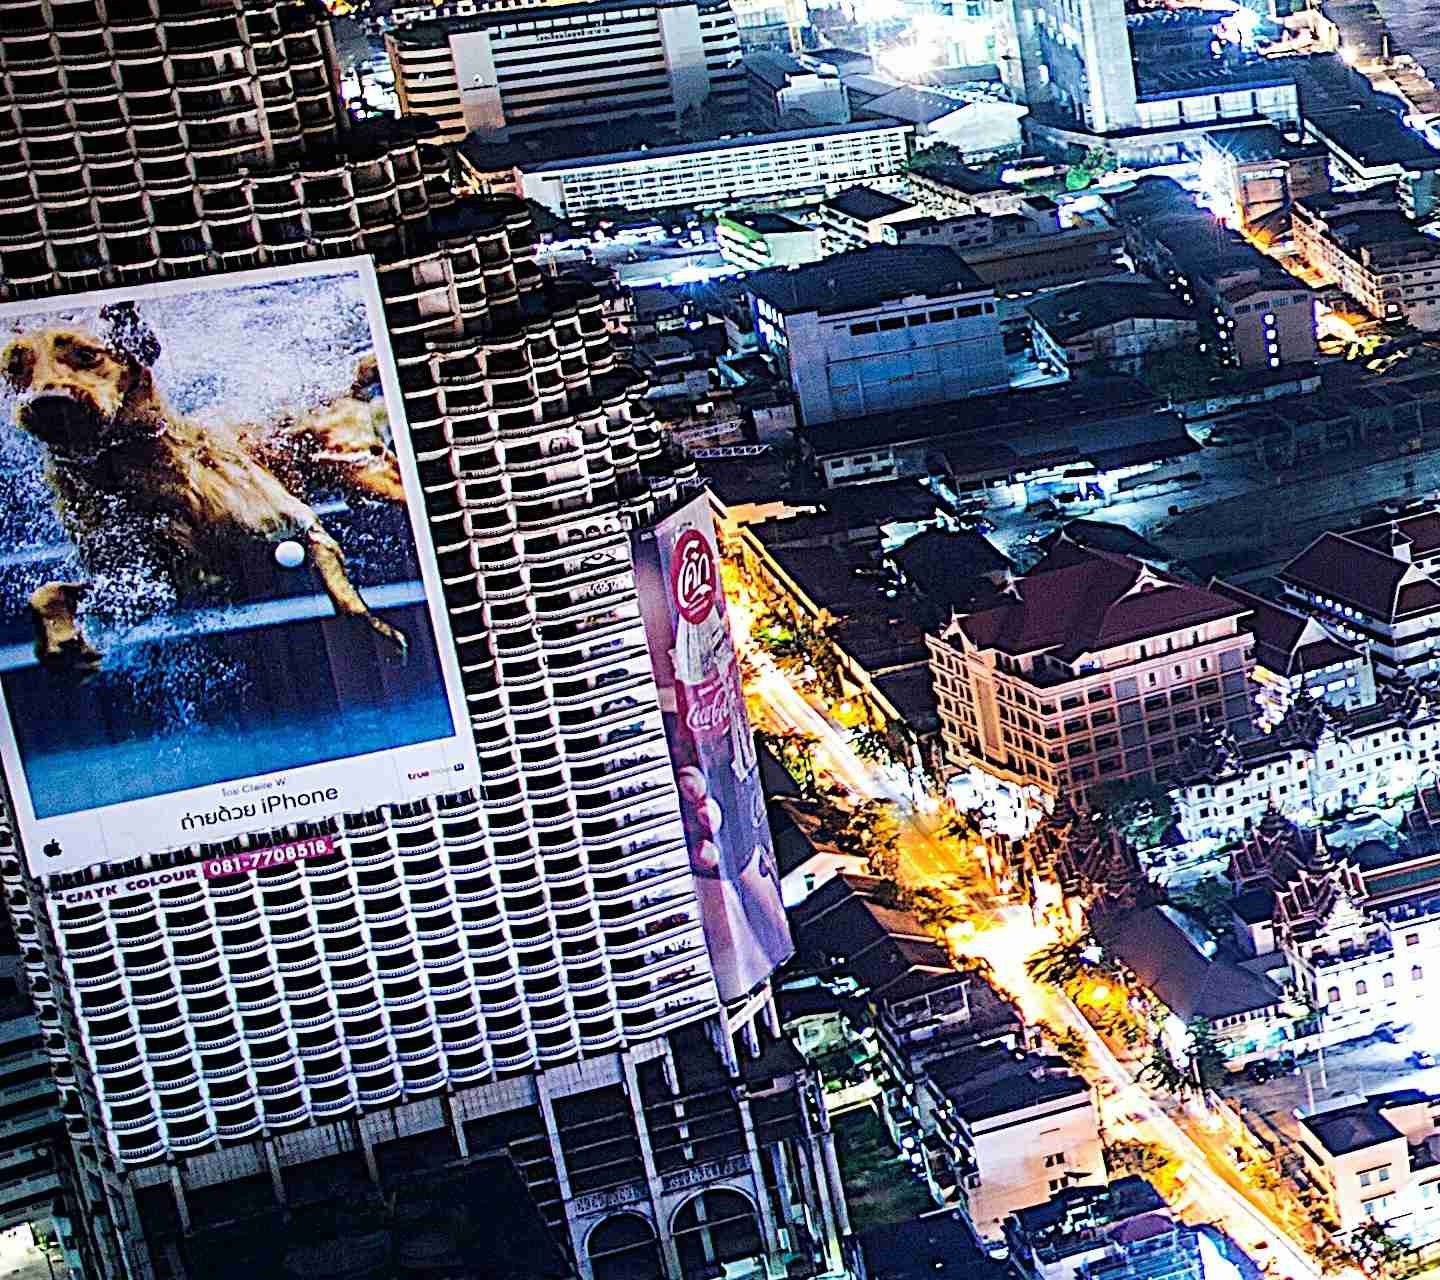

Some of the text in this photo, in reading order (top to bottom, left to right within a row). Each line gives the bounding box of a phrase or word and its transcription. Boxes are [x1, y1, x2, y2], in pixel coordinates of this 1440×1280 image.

[262, 785, 340, 814] iPhone
[66, 884, 118, 904] CMYK
[125, 869, 198, 892] COLOUR
